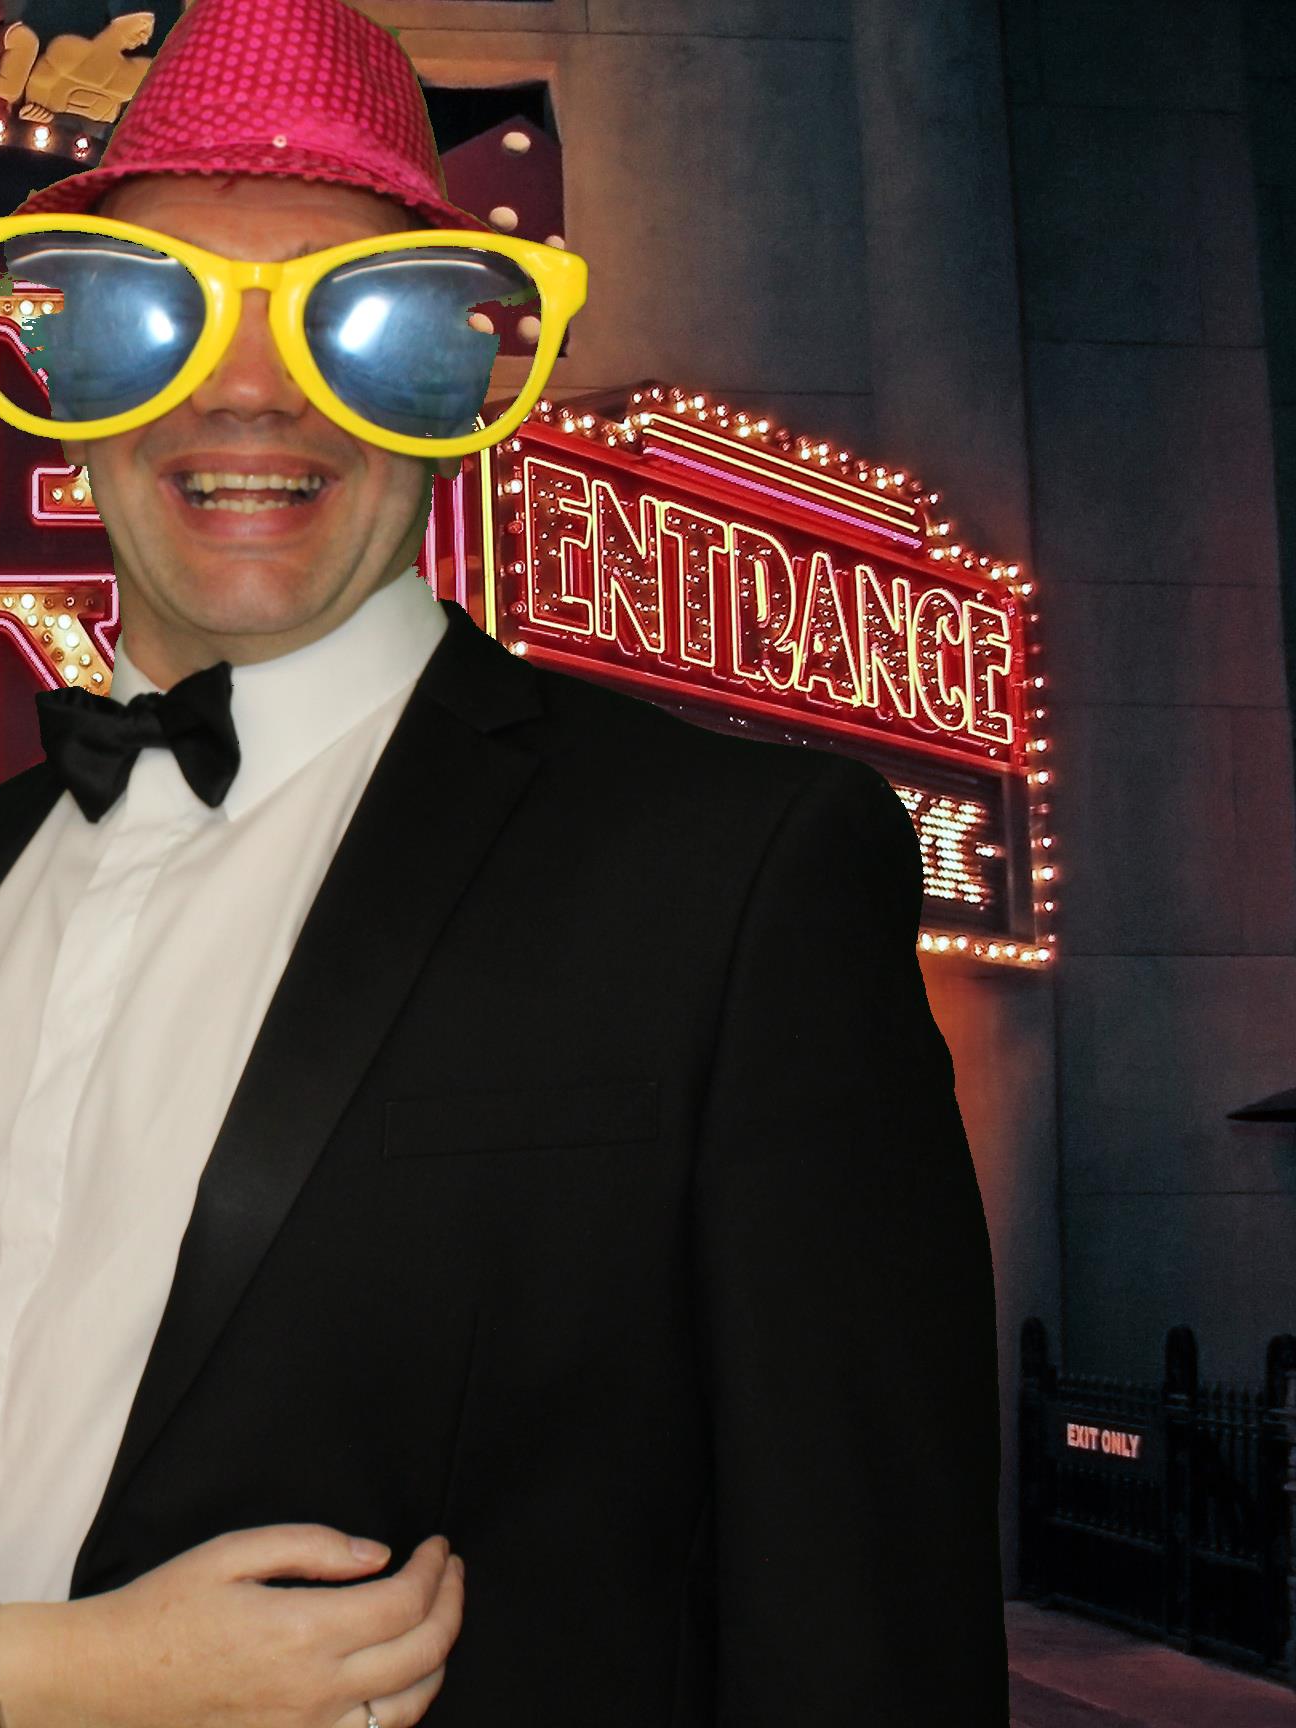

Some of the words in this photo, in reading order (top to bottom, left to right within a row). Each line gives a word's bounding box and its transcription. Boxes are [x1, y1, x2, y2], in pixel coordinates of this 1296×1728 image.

[524, 456, 1013, 744] ENTRANCE
[1067, 1422, 1099, 1450] EXIT
[1101, 1429, 1142, 1459] ONLY
